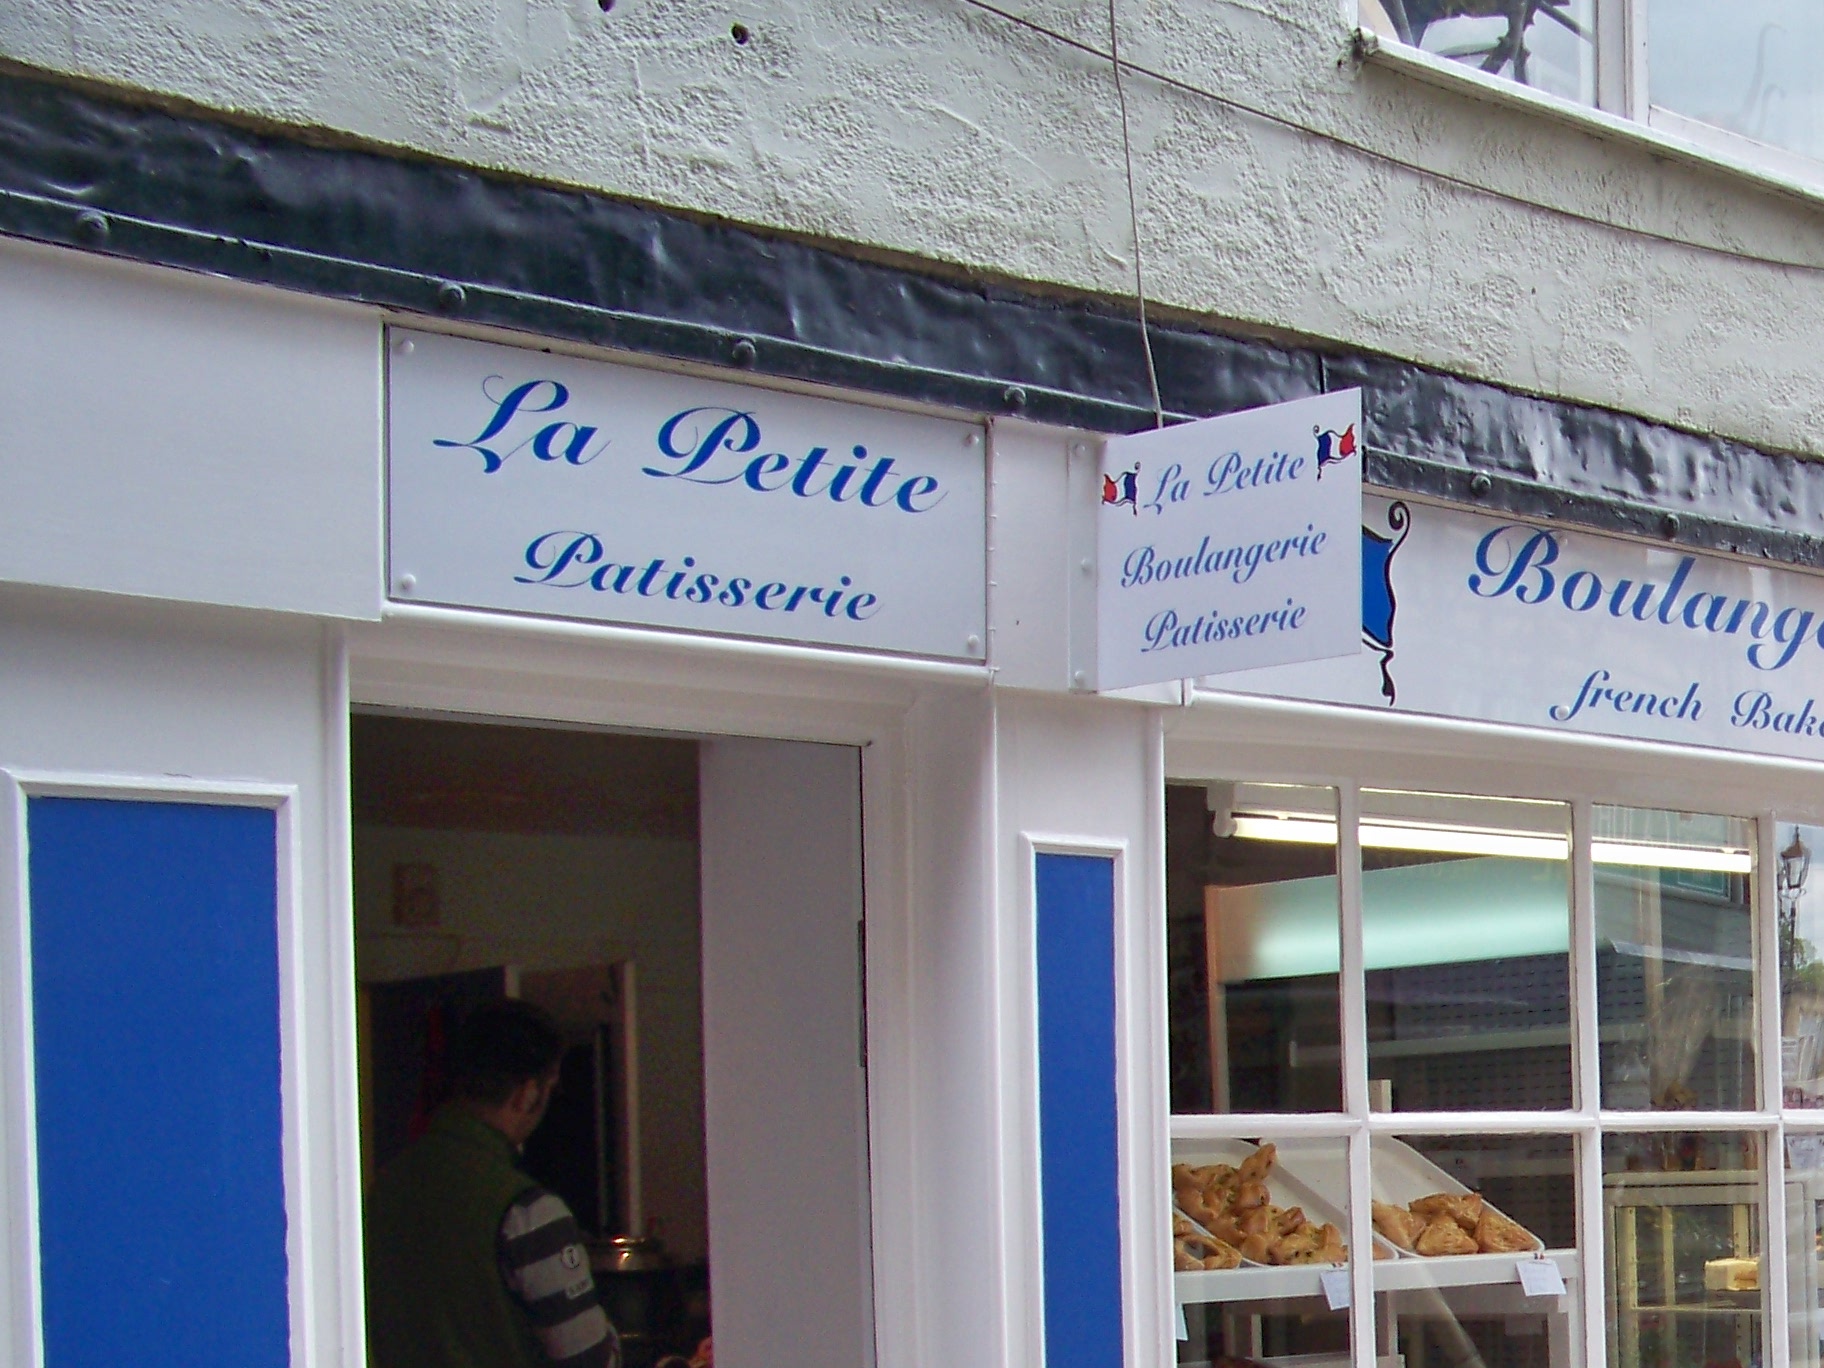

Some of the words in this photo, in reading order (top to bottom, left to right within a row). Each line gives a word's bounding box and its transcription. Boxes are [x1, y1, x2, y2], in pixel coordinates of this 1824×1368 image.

[433, 375, 611, 474] La
[642, 406, 949, 513] Petite
[1143, 463, 1191, 515] La
[1203, 451, 1305, 496] Petite
[514, 530, 881, 620] Patisserie
[1121, 523, 1327, 588] Boulangerie
[1141, 598, 1306, 652] Patisserie
[1549, 669, 1703, 722] french
